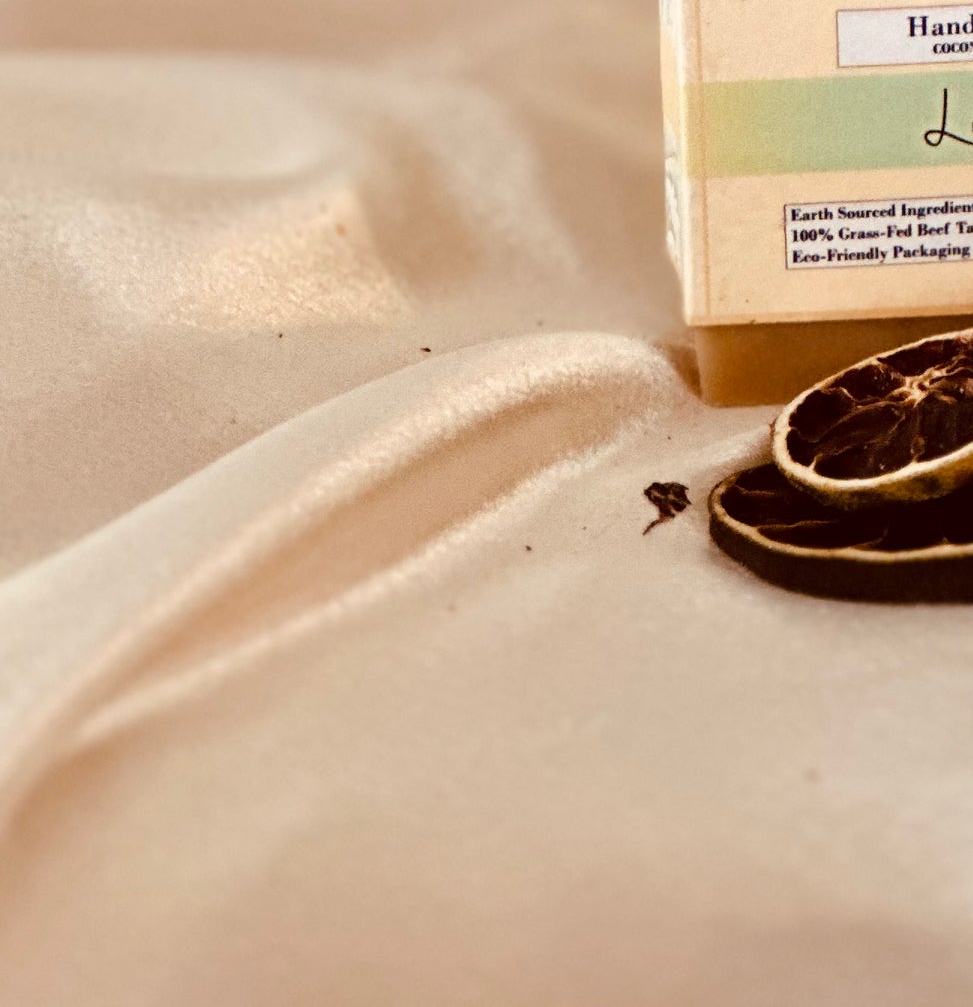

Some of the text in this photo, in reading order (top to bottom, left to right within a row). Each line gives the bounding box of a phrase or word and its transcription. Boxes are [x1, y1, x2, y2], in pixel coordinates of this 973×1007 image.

[790, 208, 833, 221] Earth
[837, 204, 896, 219] Sourced
[792, 228, 834, 242] 100%
[838, 224, 912, 240] Grass-Fed
[917, 222, 950, 236] Beef
[792, 243, 971, 263] Eco-Friendly Packaging
